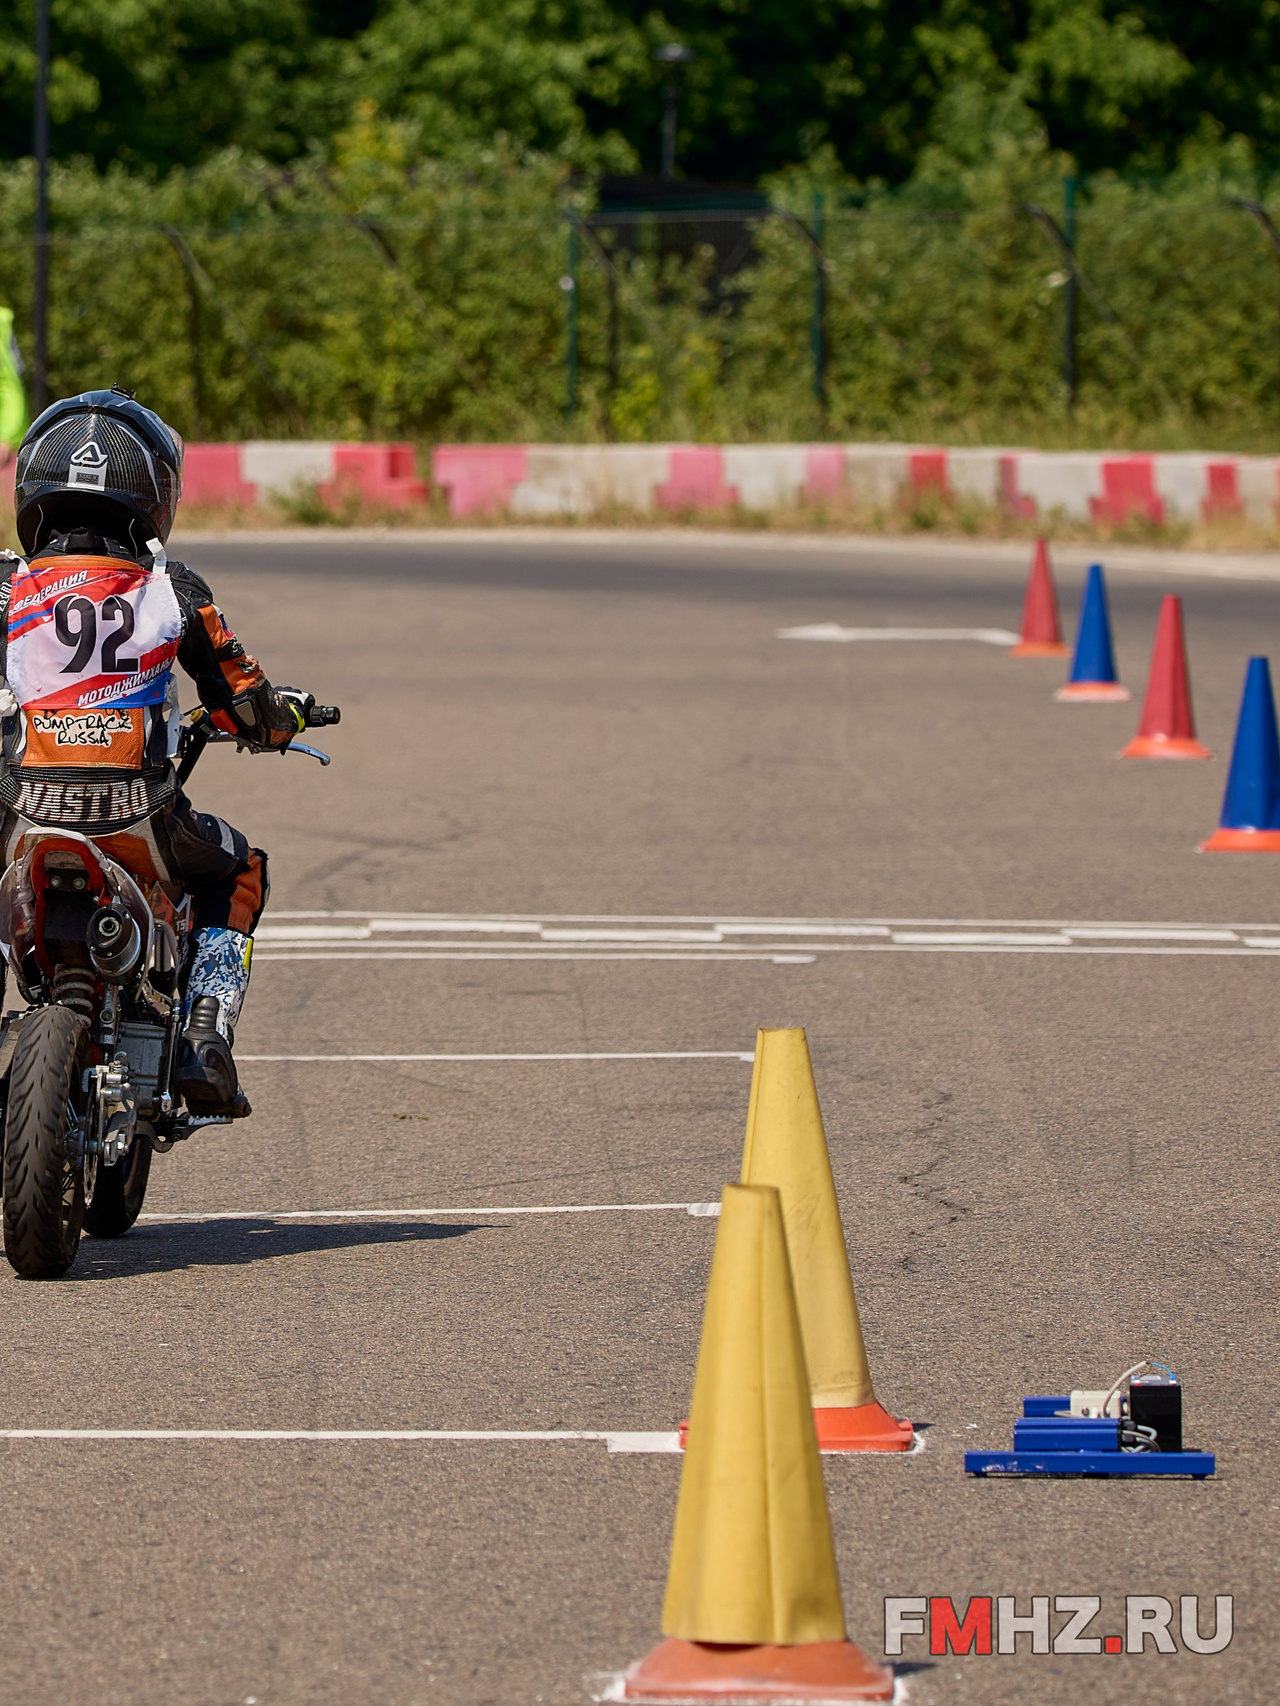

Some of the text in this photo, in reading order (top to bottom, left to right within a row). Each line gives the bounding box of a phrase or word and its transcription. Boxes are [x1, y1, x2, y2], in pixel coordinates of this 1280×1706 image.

[13, 569, 88, 611] ФЕДЕРАЦИЯ
[54, 594, 139, 674] 92
[33, 715, 132, 731] PUMPTRACK
